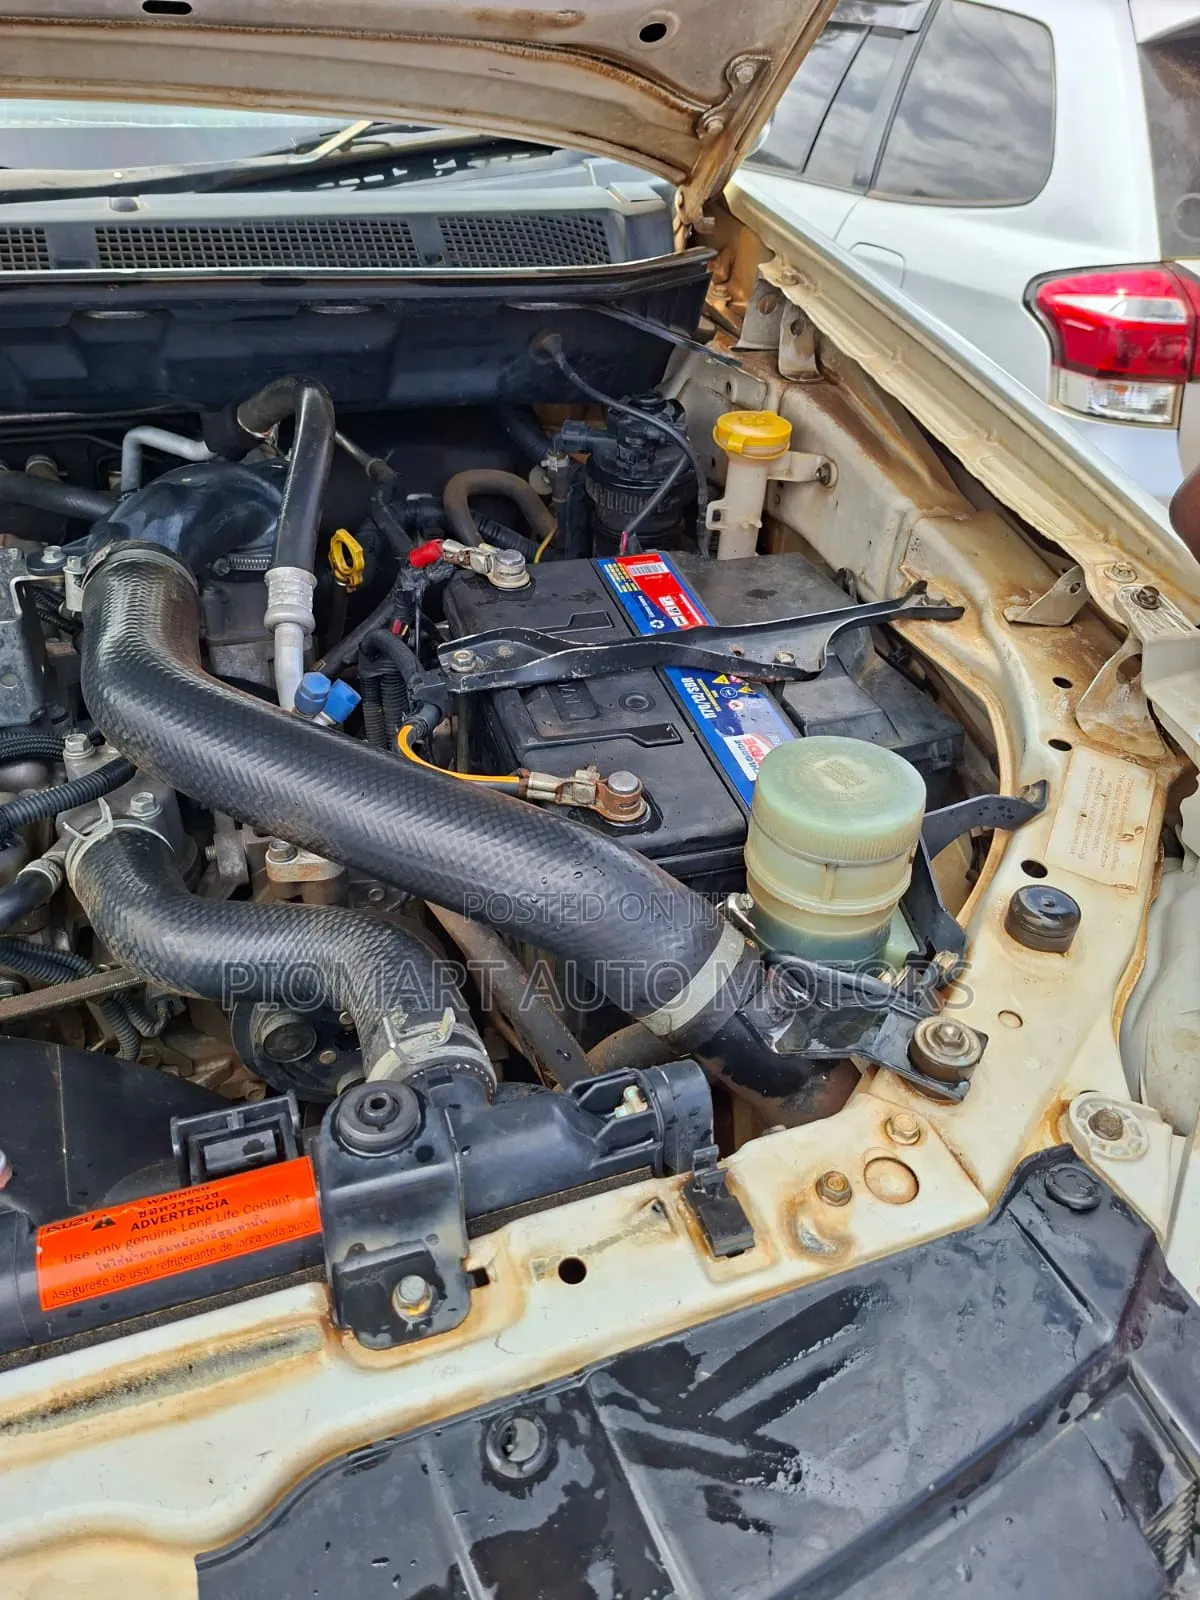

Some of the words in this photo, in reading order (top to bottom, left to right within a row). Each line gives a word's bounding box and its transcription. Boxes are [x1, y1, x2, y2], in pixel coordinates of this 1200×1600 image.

[734, 739, 760, 776] HLORIDE
[146, 1186, 210, 1205] WARNING
[131, 1198, 230, 1233] ADVERTENCIA
[64, 1251, 90, 1265] Use
[95, 1241, 121, 1257] only
[126, 1227, 177, 1250] genuine
[181, 1217, 213, 1232] Long
[216, 1209, 239, 1222] Life
[113, 1272, 126, 1284] de
[130, 1265, 153, 1279] usar
[156, 1246, 217, 1269] refrigerante
[219, 1243, 233, 1253] de
